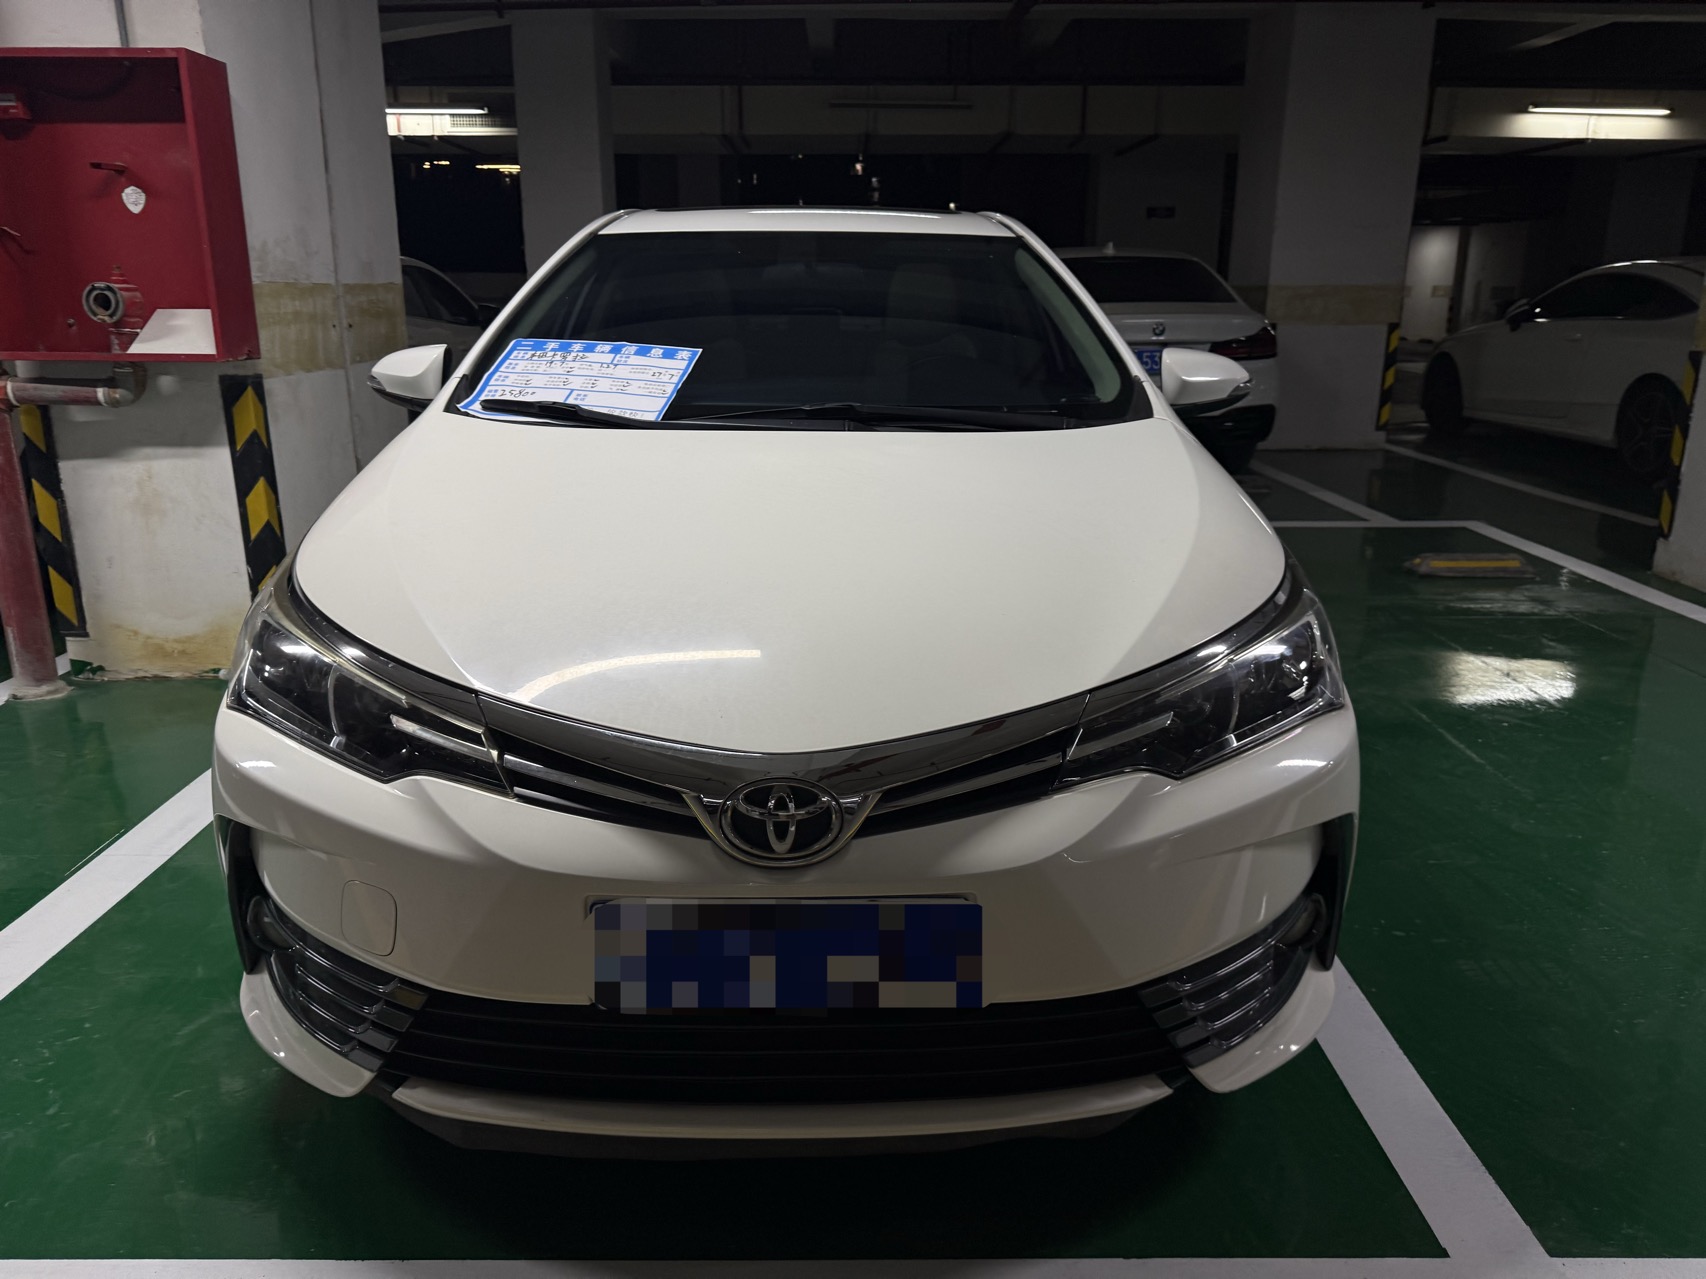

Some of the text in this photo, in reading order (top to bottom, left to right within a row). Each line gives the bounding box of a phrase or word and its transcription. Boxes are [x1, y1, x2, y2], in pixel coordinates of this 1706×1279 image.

[516, 341, 693, 361] 二手车辆信息表
[498, 388, 536, 398] 25800
